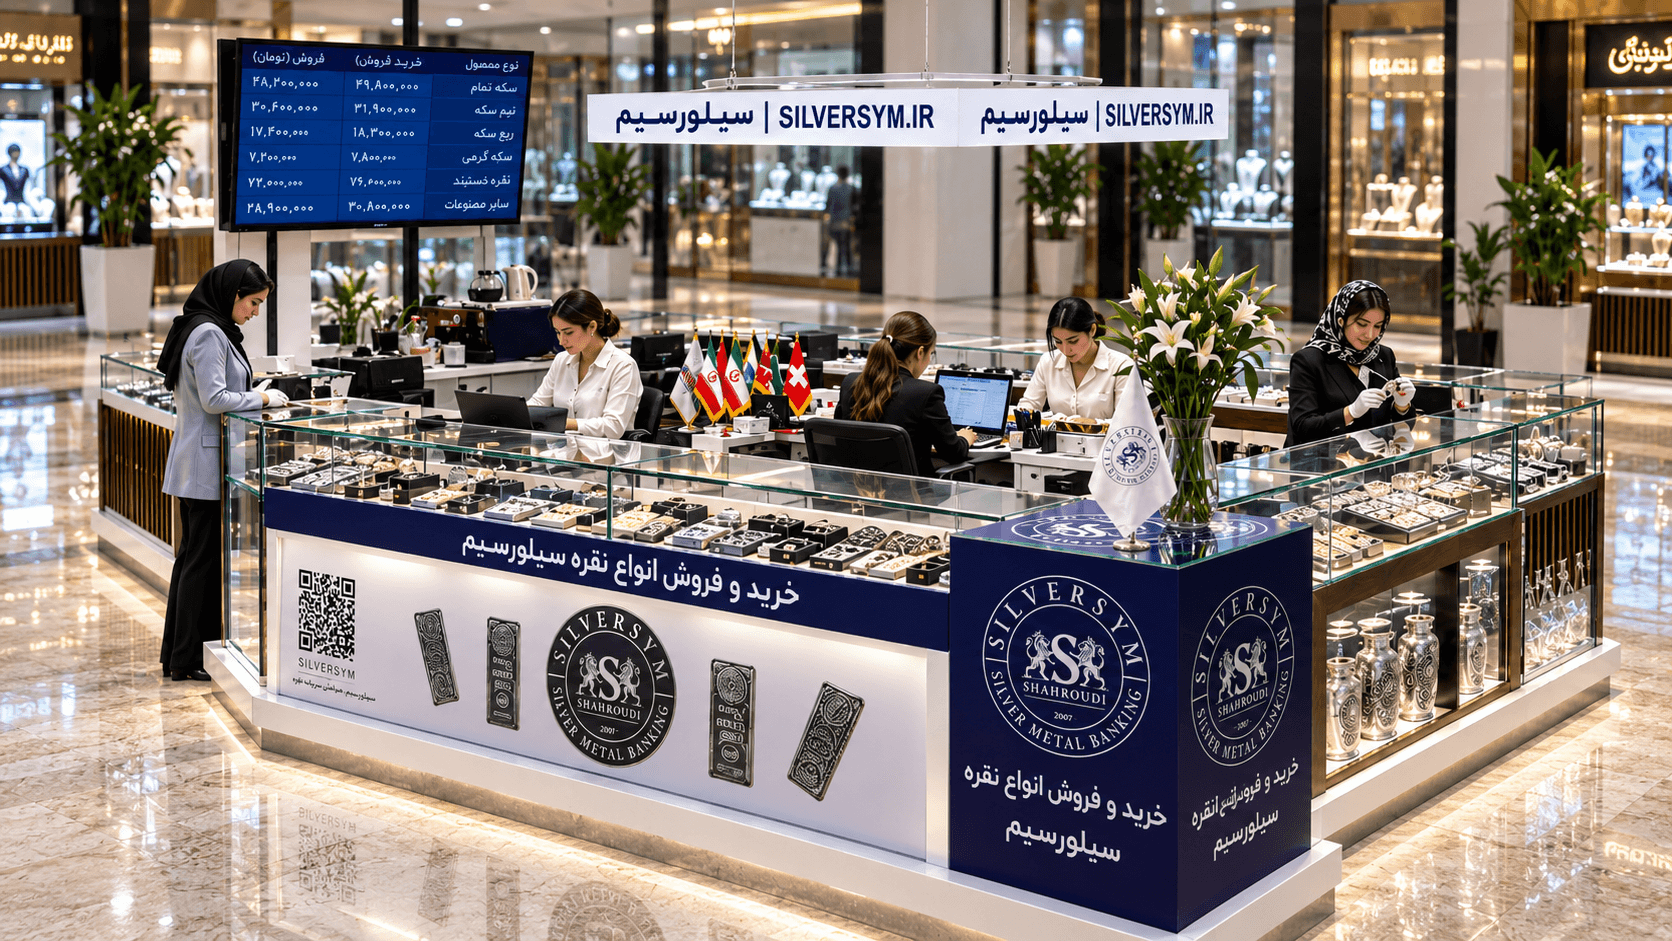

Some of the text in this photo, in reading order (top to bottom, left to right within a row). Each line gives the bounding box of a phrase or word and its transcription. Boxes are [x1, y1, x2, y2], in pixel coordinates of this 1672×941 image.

[502, 60, 519, 73] نوع
[470, 81, 518, 95] سکه تمام
[474, 104, 498, 115] سکه
[615, 100, 935, 134] سیلورسیم SILVERSYM.IR
[980, 100, 1215, 134] سیلورسیم SILVERSYM.IR
[473, 128, 497, 138] سکه
[461, 533, 800, 610] خرید و فروش انواع نقره سیلورسیم
[988, 581, 1144, 666] SILVERSYM
[1195, 592, 1290, 684] SILVERSYM
[553, 610, 670, 681] SILVERSYM
[298, 657, 356, 680] SILVERSYM
[576, 698, 641, 720] SHAHROUDI
[1023, 681, 1106, 705] SHAHROUDI
[1217, 686, 1269, 718] SHAHROUDI
[1028, 723, 1085, 751] METAL
[1088, 688, 1142, 748] BANKING
[1053, 711, 1073, 722] 2007
[1221, 737, 1258, 760] METAL
[1258, 670, 1289, 740] BANKING
[579, 735, 624, 761] METAL
[627, 704, 669, 759] BANKING
[1264, 776, 1271, 794] و
[1273, 757, 1299, 786] خرید
[964, 764, 1167, 830] خرید و فروش انواع نقره
[1005, 820, 1121, 864] سیلورسیم
[1213, 810, 1279, 862] سیلورسیم
